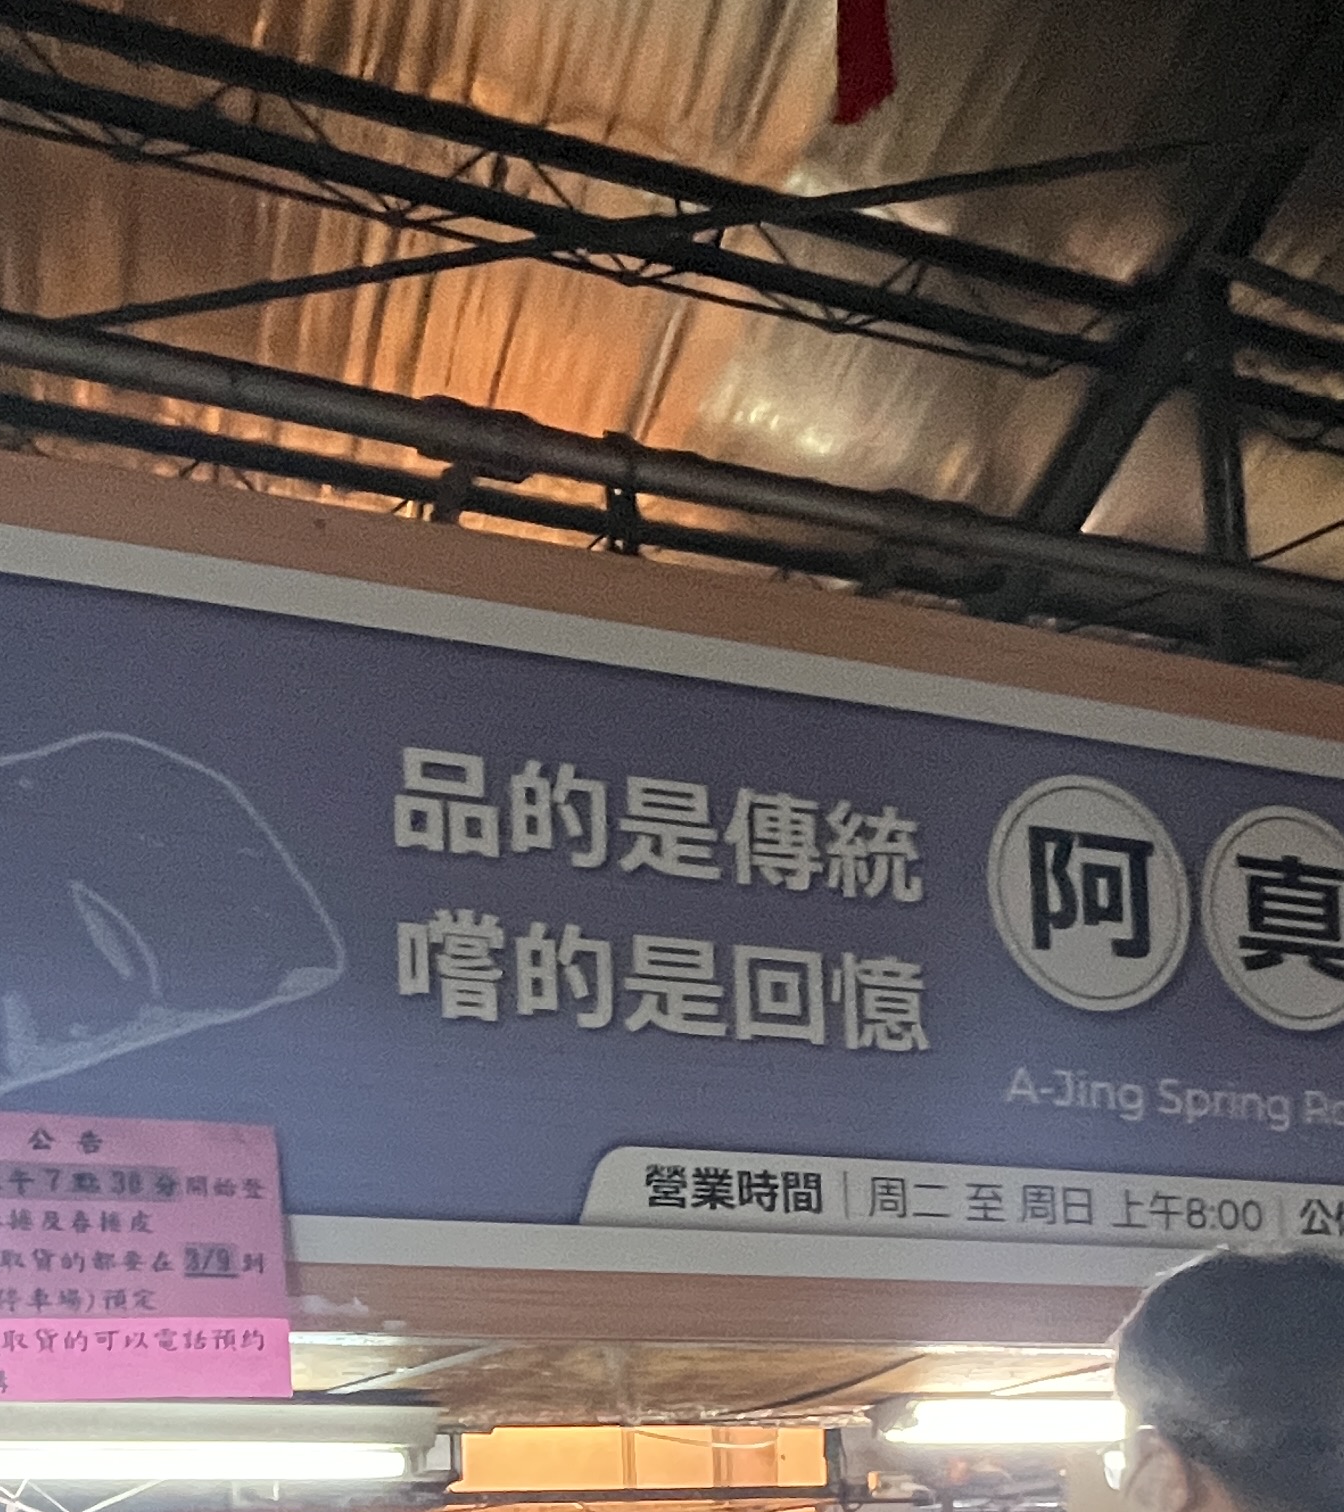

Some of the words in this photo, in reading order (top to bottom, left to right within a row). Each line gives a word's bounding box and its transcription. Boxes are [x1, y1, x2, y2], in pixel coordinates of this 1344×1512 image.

[393, 746, 924, 902] 品的是傳統
[396, 908, 930, 1051] 嚐的是回憶
[1006, 1067, 1144, 1121] A-Jing
[1158, 1078, 1290, 1131] Spring
[644, 1163, 824, 1214] 營業時間
[868, 1176, 949, 1219] 周二
[966, 1183, 1006, 1223] 至
[1020, 1186, 1093, 1226] 周日
